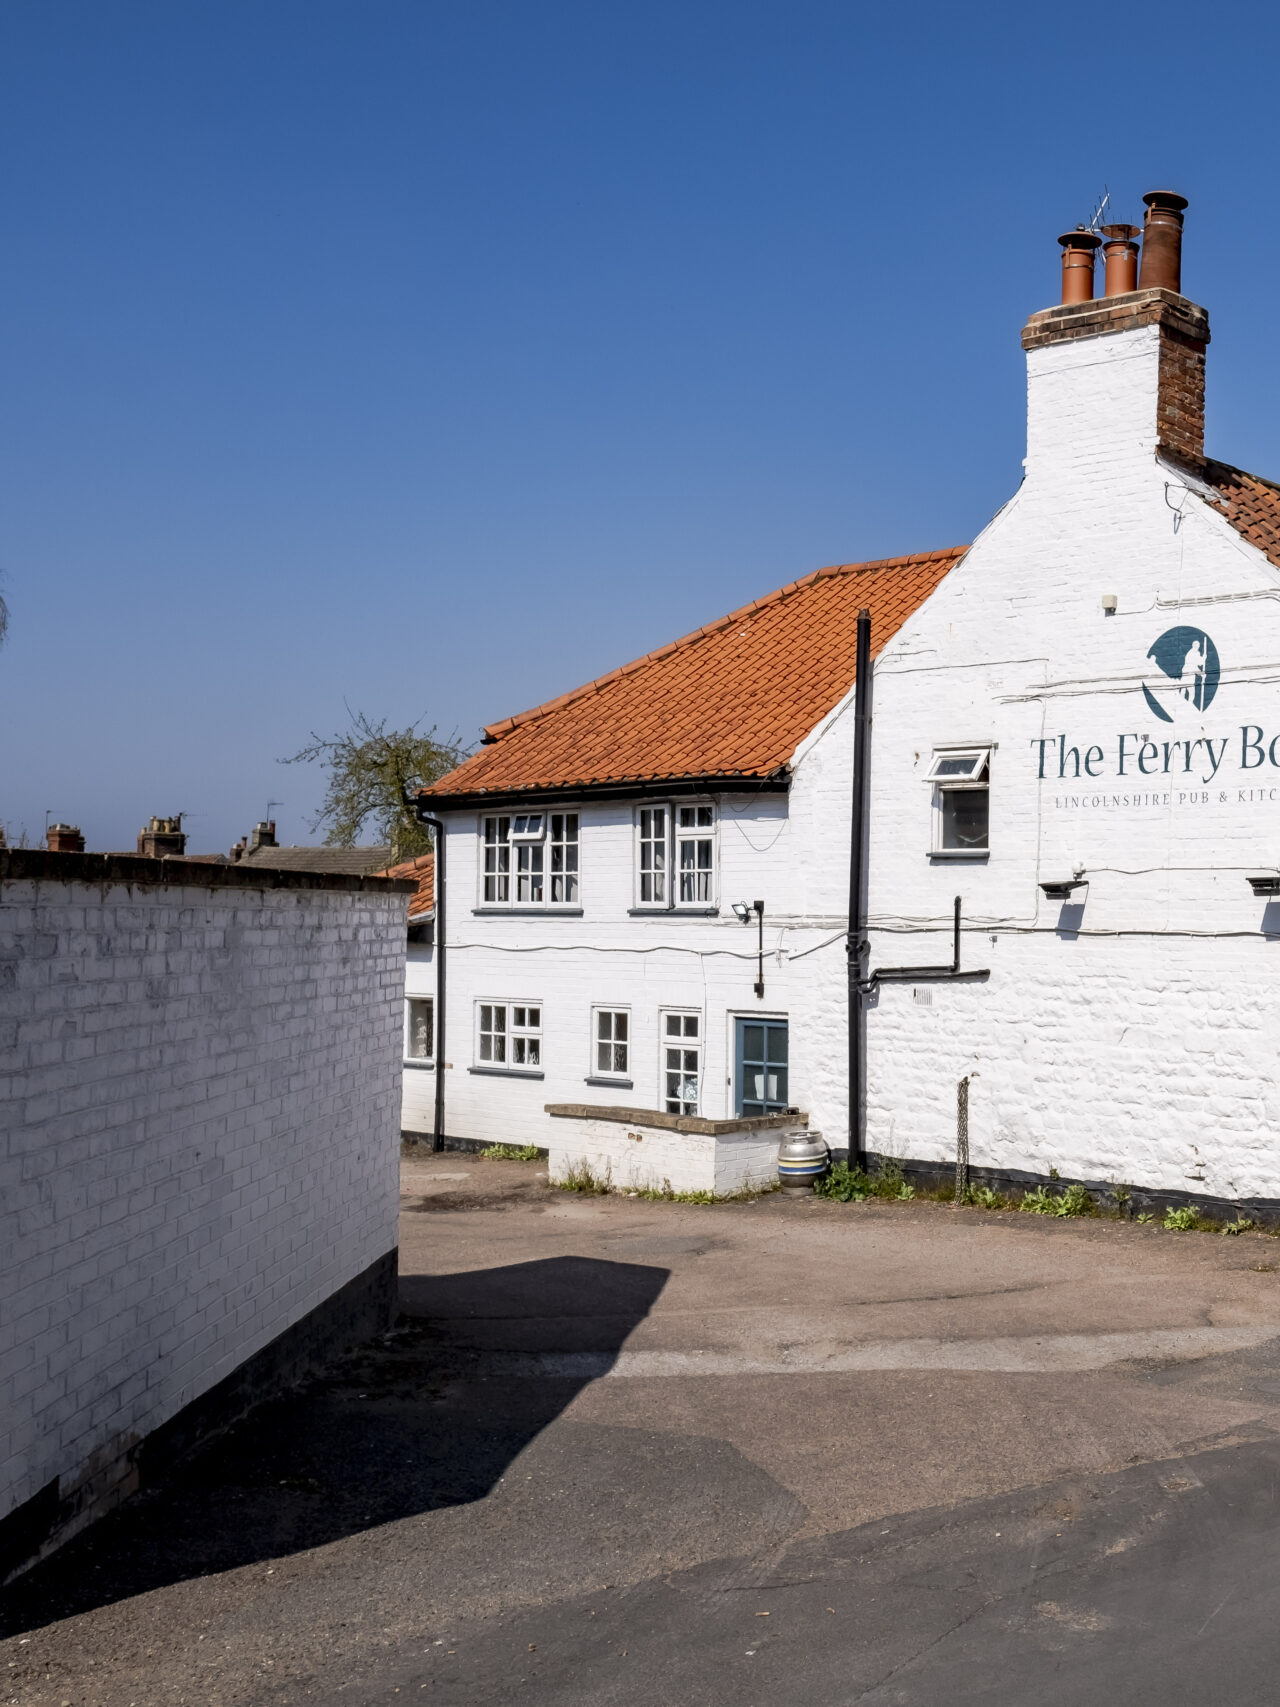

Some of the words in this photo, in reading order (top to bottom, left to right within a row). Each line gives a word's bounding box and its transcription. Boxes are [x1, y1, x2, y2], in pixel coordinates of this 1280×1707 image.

[1030, 733, 1104, 779] The
[1116, 733, 1230, 784] Ferry
[1055, 793, 1170, 809] LINCOLNSHIRE
[1179, 791, 1209, 805] PUB
[1219, 791, 1228, 803] &
